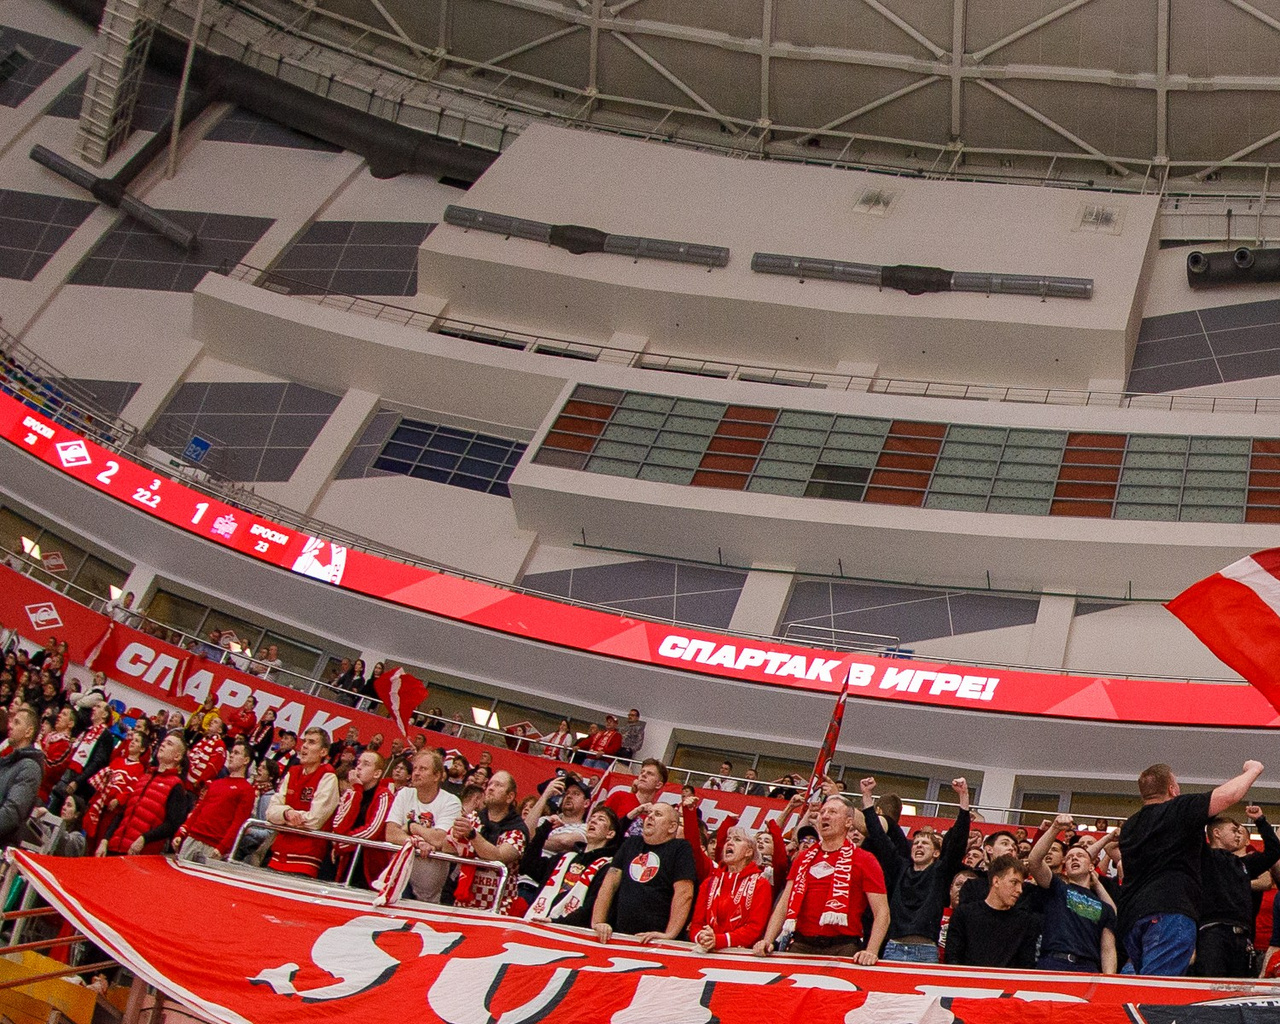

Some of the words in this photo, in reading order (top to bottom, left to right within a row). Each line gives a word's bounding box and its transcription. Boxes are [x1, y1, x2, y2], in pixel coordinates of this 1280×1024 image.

[96, 460, 119, 485] 2
[149, 478, 161, 490] 3
[191, 502, 209, 524] 1
[249, 523, 289, 545] БРОСКИ
[658, 635, 843, 683] СПАРТАК
[842, 662, 876, 687] В
[878, 667, 1001, 701] ИГРЕ!
[116, 641, 352, 742] СПАРТАК
[472, 874, 499, 888] СКВА
